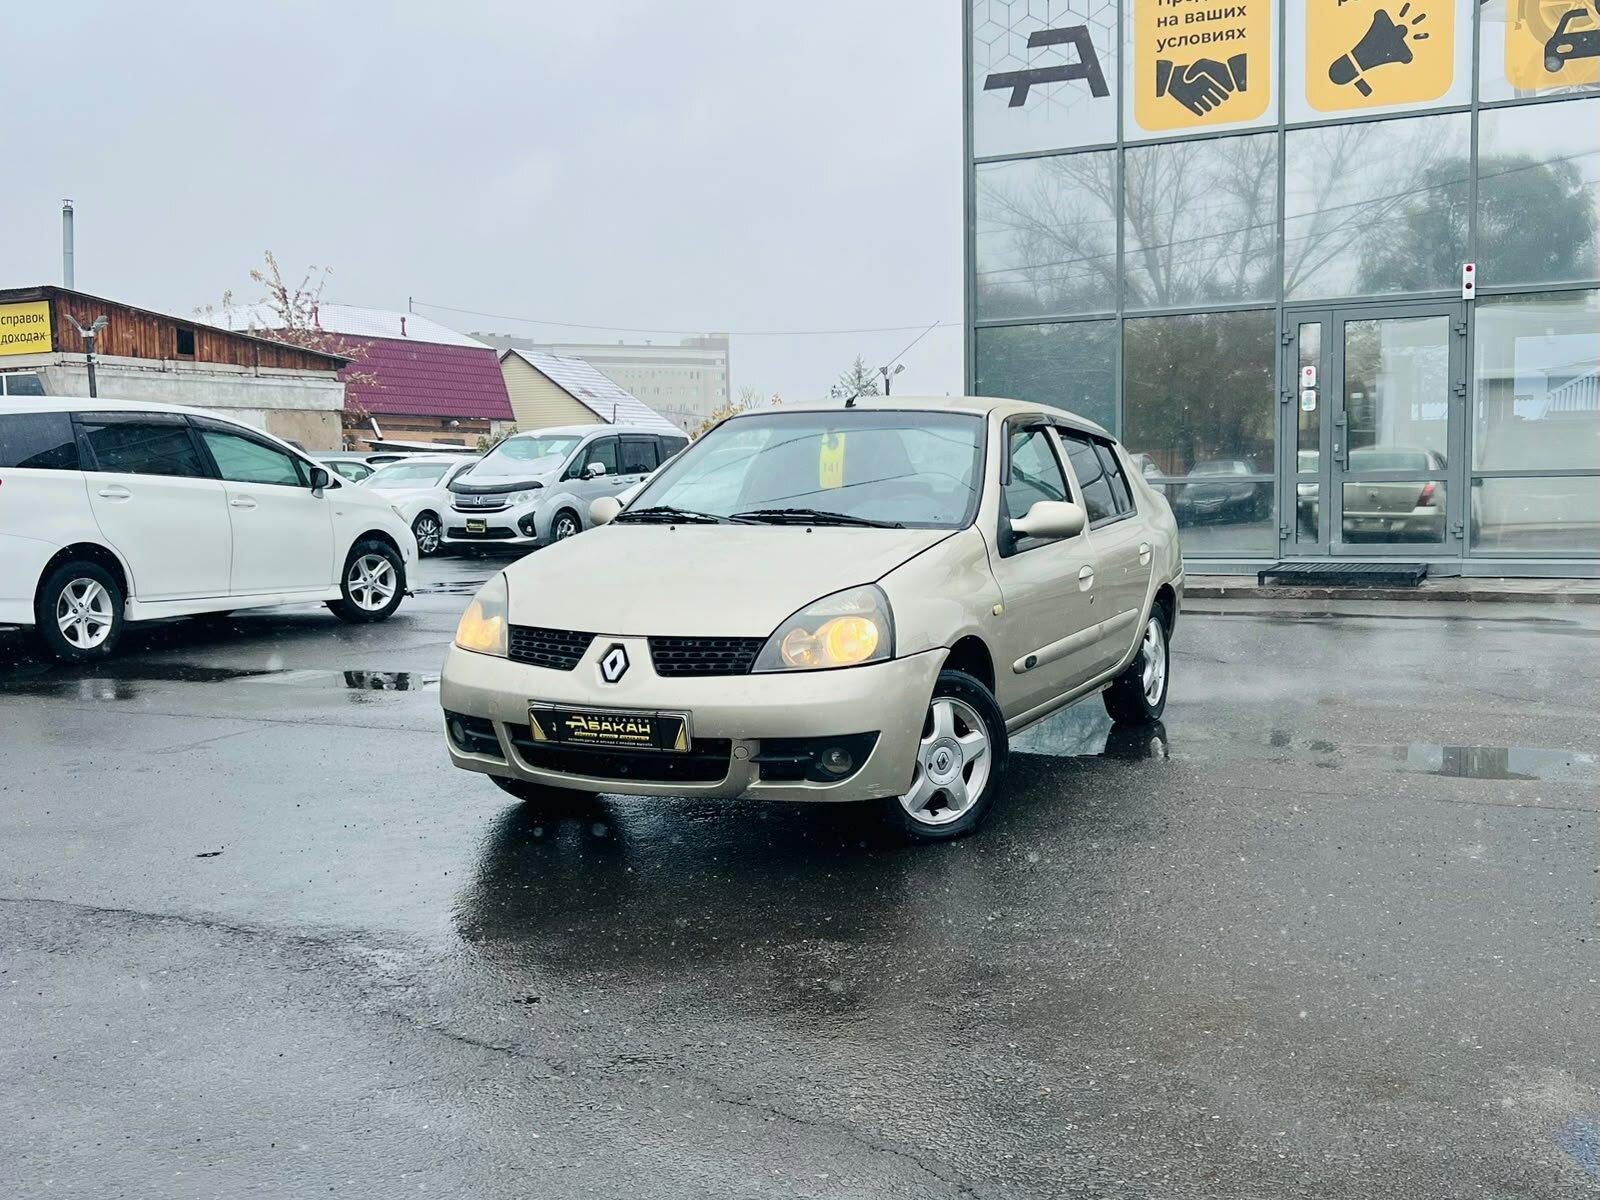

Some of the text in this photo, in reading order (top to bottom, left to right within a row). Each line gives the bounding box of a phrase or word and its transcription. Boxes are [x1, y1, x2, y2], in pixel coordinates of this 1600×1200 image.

[1157, 5, 1247, 28] на ваших
[1156, 27, 1246, 53] условиях
[1, 314, 45, 327] справок
[0, 332, 46, 345] доходах
